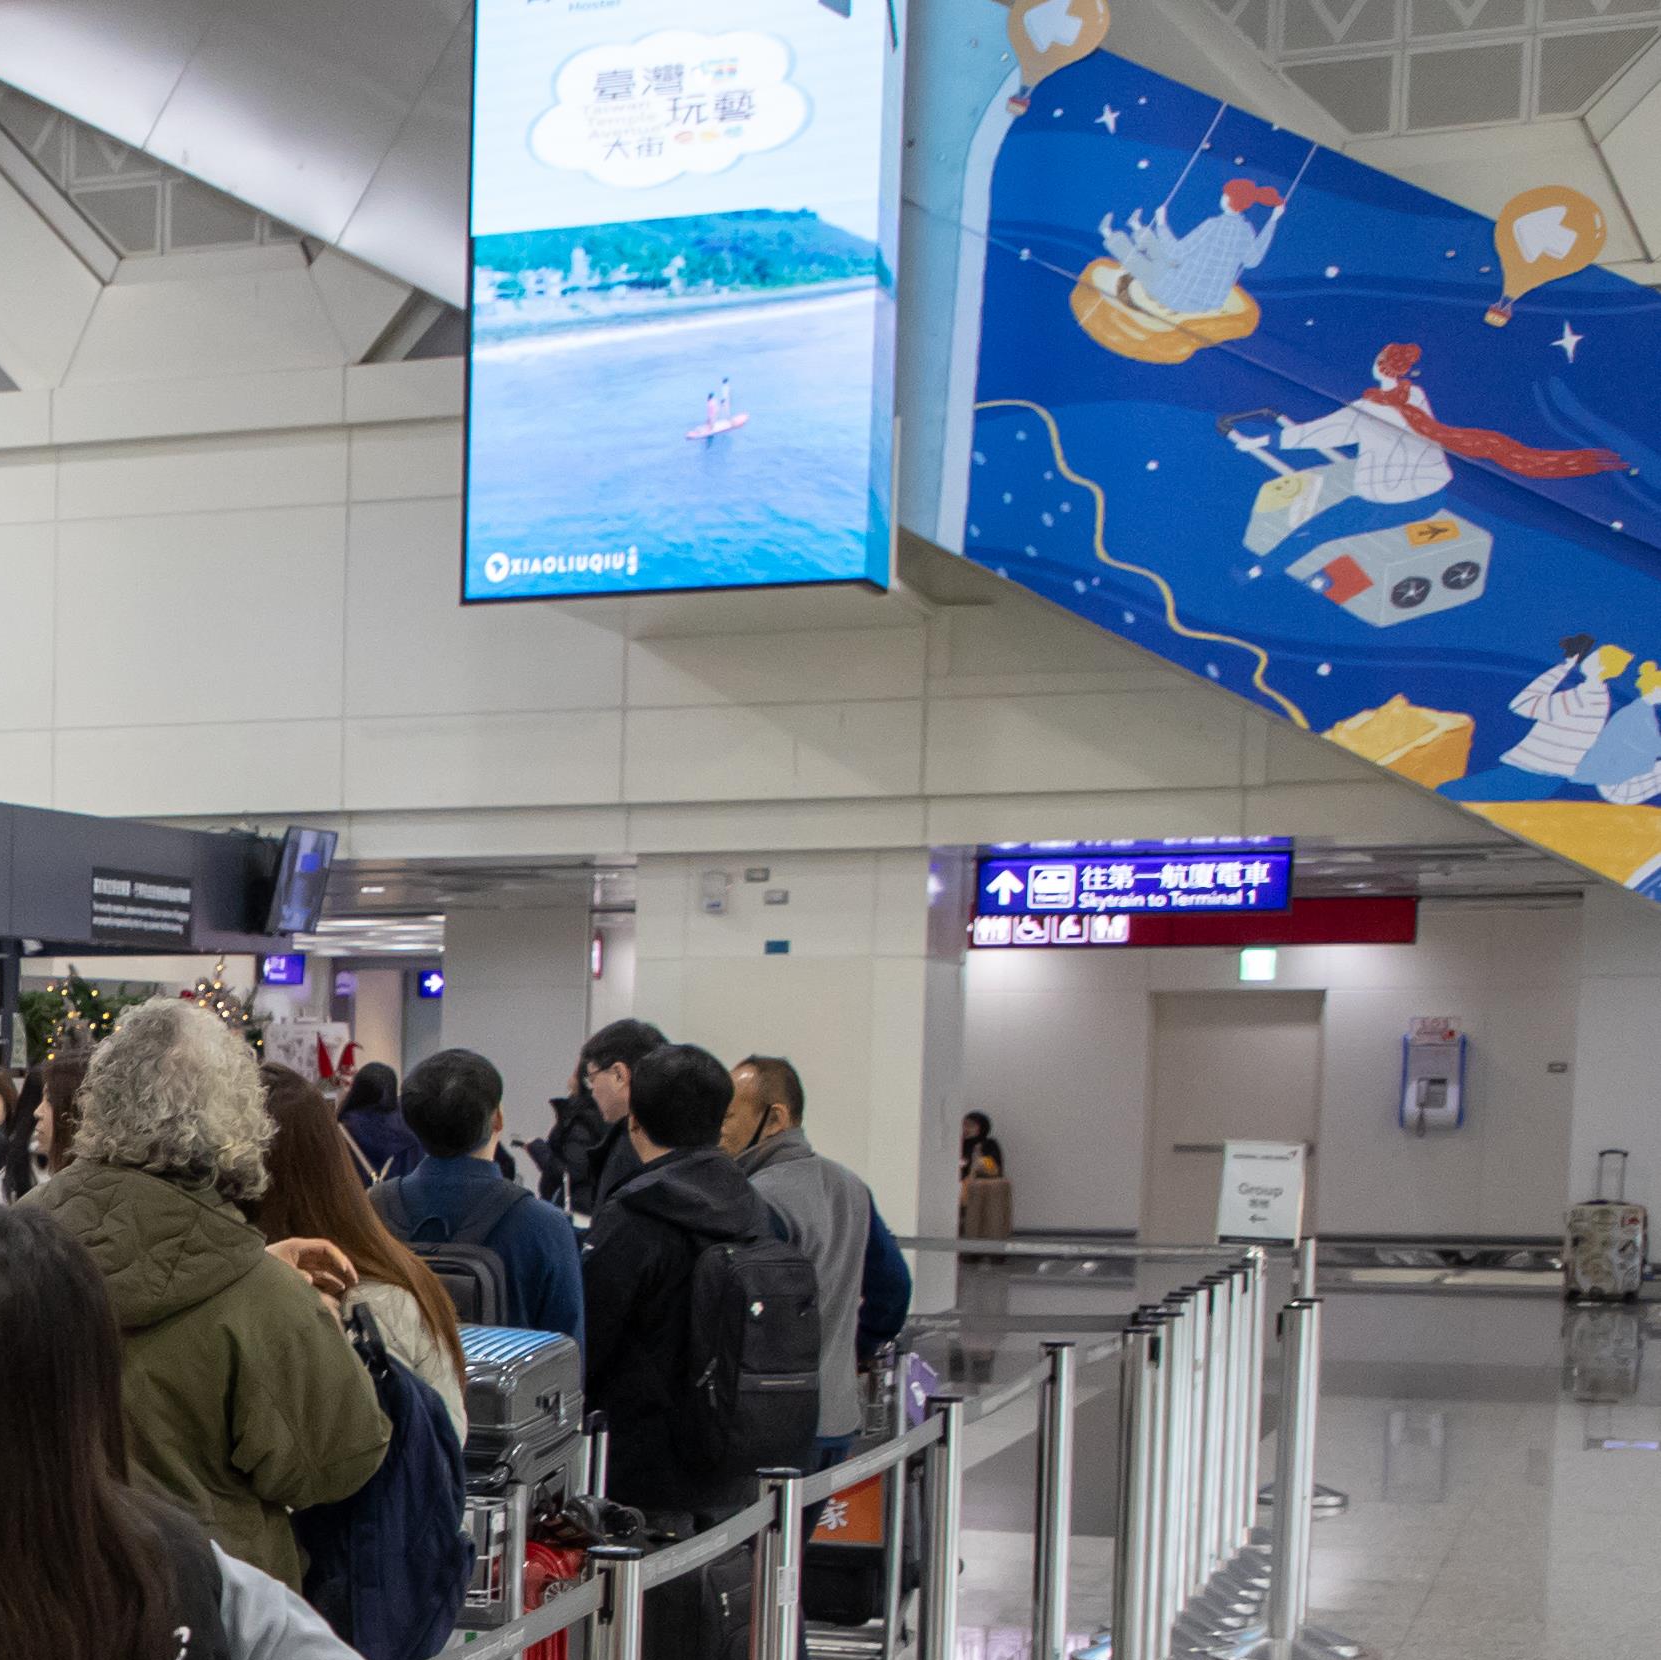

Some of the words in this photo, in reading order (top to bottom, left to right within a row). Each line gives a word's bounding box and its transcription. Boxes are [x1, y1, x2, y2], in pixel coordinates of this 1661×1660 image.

[593, 62, 686, 102] 臺灣
[602, 136, 666, 161] 大街
[510, 551, 627, 576] XIAOLIUQIU
[1080, 860, 1271, 891] 往第一航廈電車
[1146, 890, 1167, 908] to
[1168, 889, 1243, 908] Terminal
[1246, 888, 1257, 905] 1
[1238, 1181, 1284, 1199] Group
